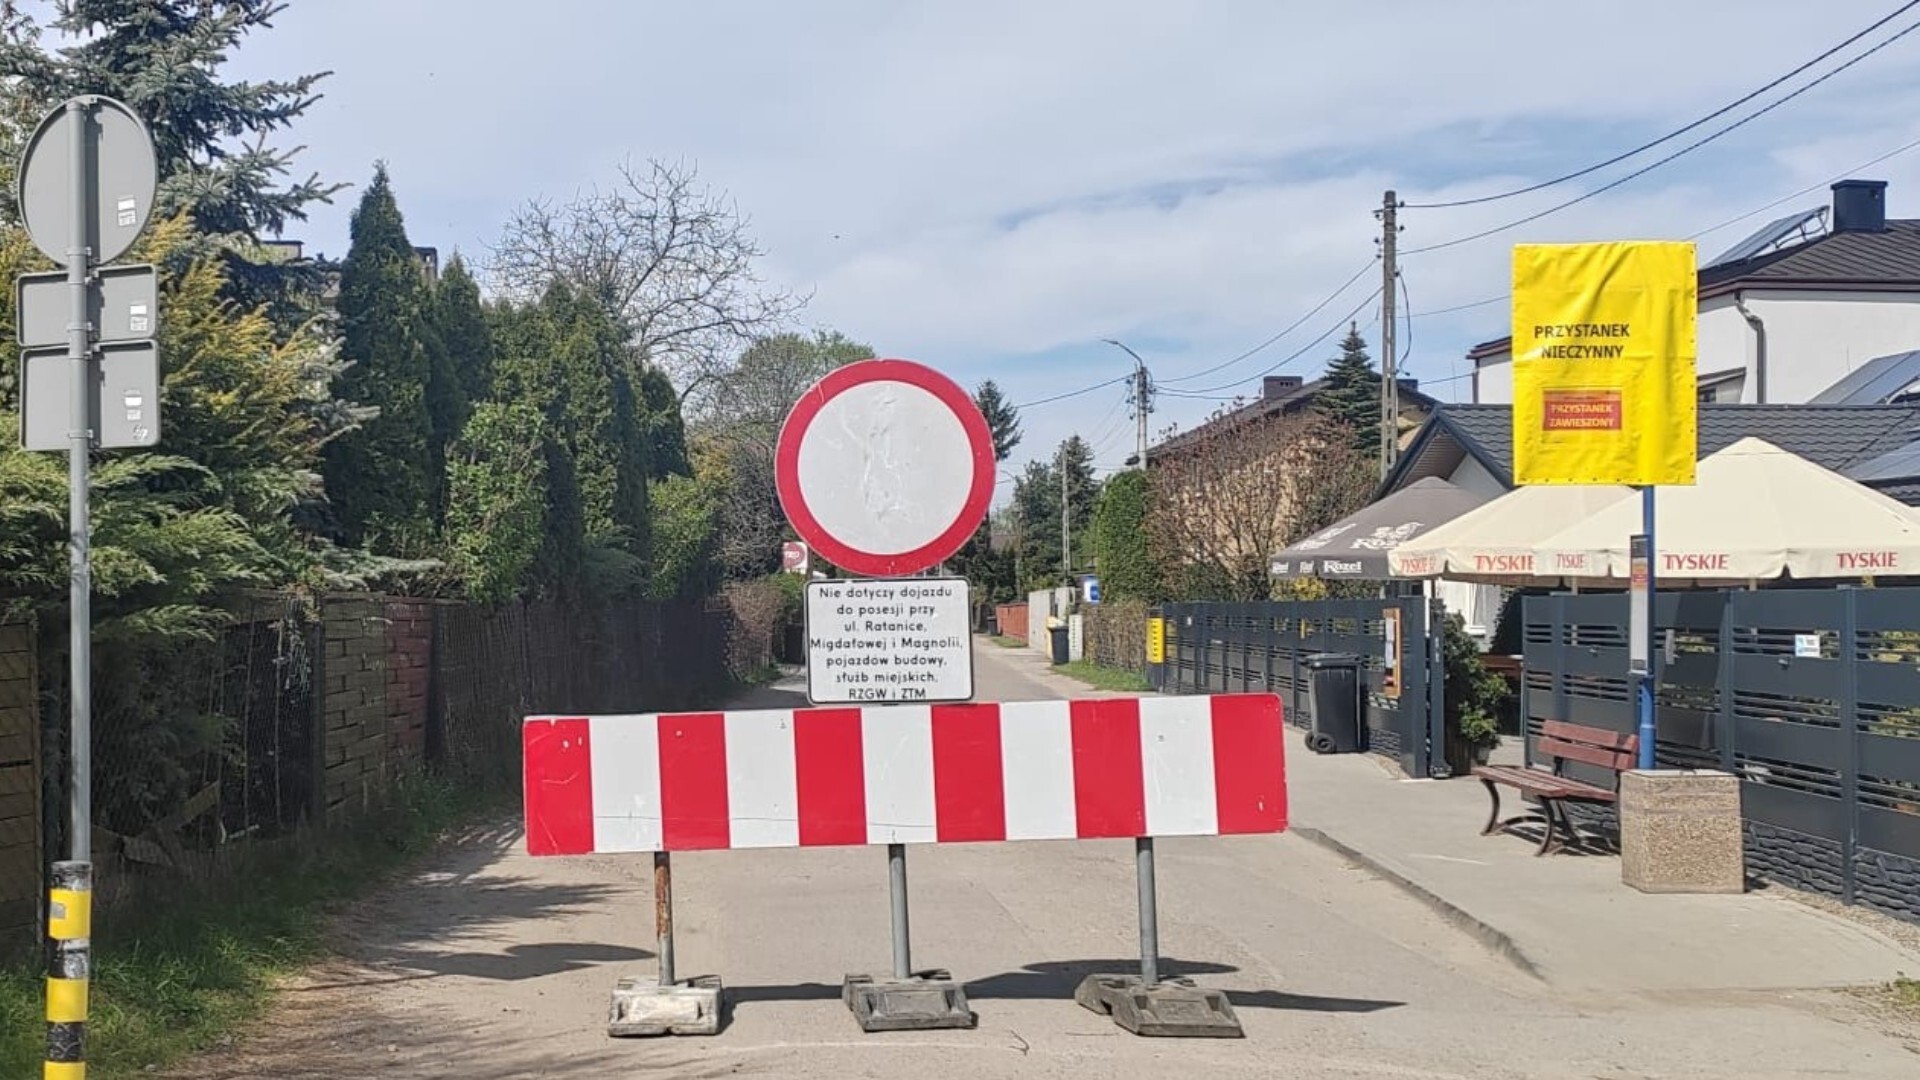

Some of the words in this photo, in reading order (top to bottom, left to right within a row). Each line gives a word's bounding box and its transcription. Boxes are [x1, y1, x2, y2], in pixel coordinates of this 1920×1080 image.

[1534, 324, 1630, 338] PRZYSTANEK
[1541, 345, 1624, 358] NIECZYNNY
[1551, 404, 1613, 413] PRZYSTANEK
[1549, 418, 1615, 427] ZAWIESZONY
[1323, 560, 1362, 573] Kozel
[1556, 553, 1585, 568] TYSKIE
[1663, 554, 1730, 570] TYSKIE
[1837, 552, 1899, 568] TYSKIE
[819, 587, 841, 598] Nie
[846, 587, 894, 600] dotyczy
[900, 586, 952, 600] dojazdu
[837, 604, 853, 615] do
[859, 602, 904, 617] posesji
[909, 605, 935, 617] przy
[844, 621, 859, 632] ul.
[865, 620, 927, 633] Ratanice,
[810, 637, 887, 652] Migdałowej
[892, 637, 896, 648] i
[901, 636, 963, 651] Magnolii,
[826, 654, 888, 669] pojazdów
[836, 671, 869, 683] służb
[848, 688, 887, 700] RZGW
[892, 688, 896, 699] i
[901, 687, 926, 699] ZTM
